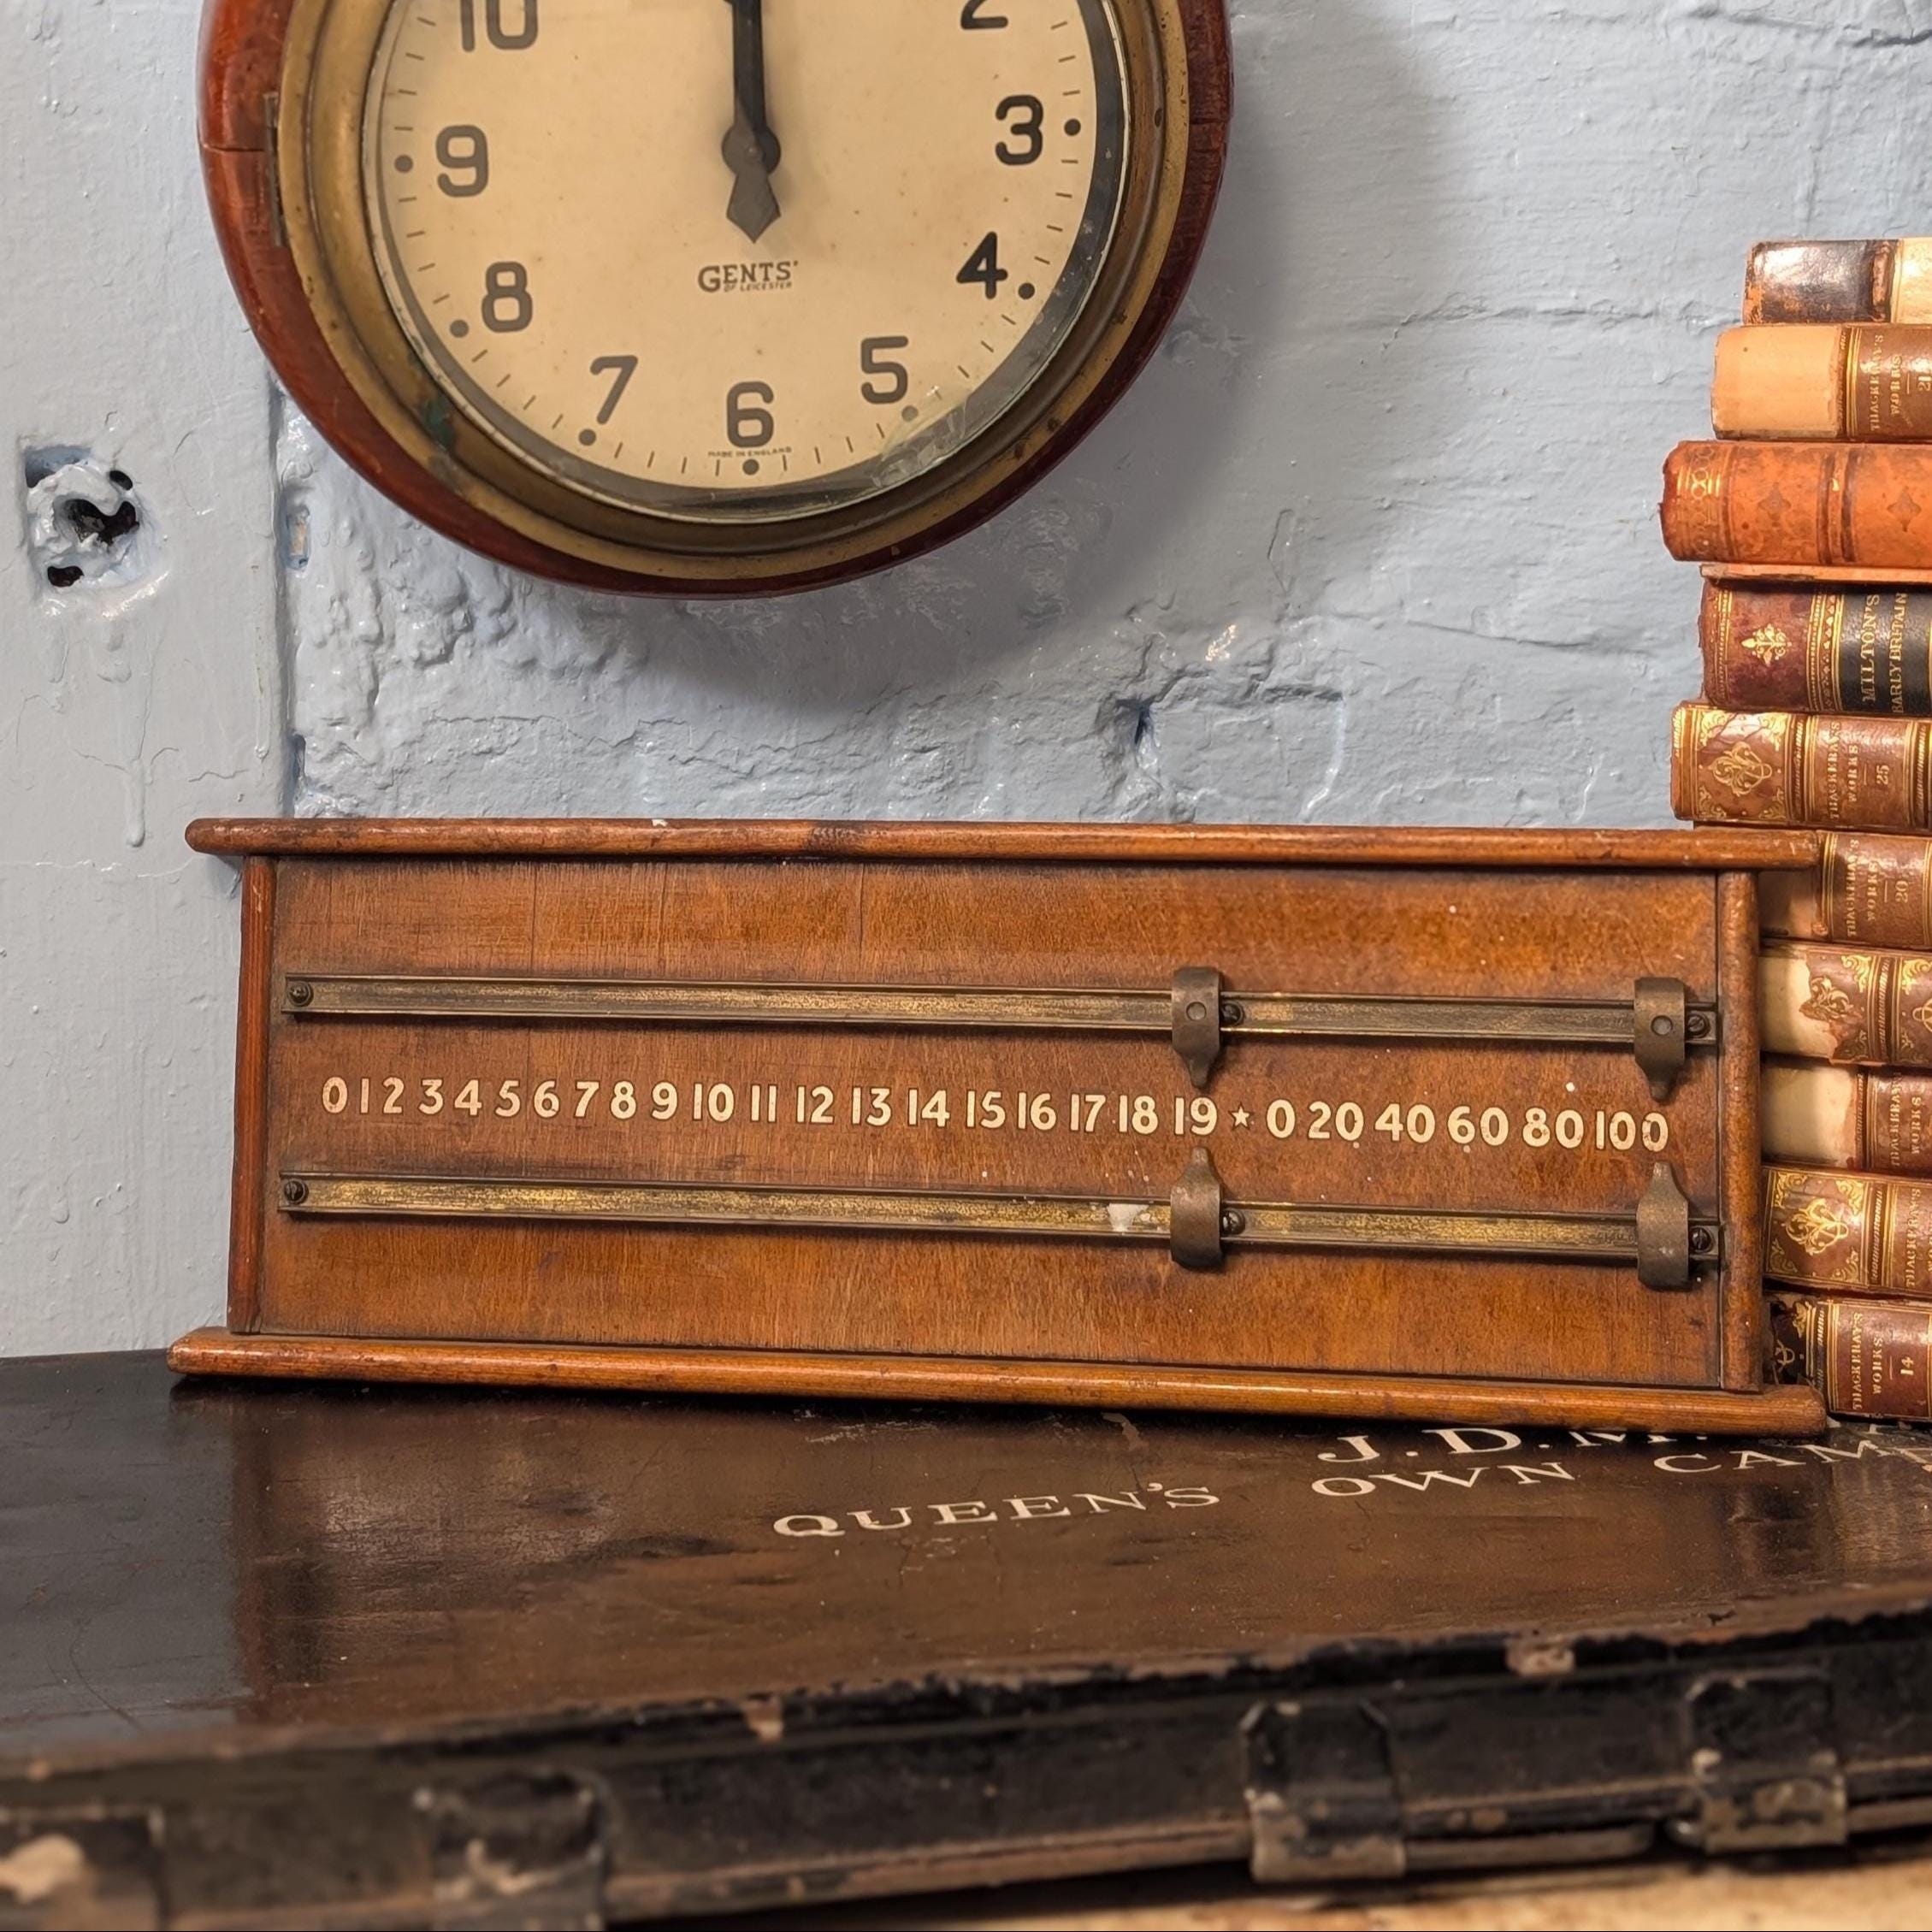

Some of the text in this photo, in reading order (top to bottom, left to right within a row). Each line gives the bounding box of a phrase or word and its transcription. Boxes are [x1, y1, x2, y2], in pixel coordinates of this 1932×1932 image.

[460, 0, 538, 52] 10
[996, 94, 1044, 165] 3
[435, 125, 488, 198] 9
[482, 261, 533, 333] 8
[698, 260, 798, 292] GENTS'
[740, 281, 792, 292] LEICESTER
[955, 232, 1008, 299] 4
[590, 355, 639, 425] 7
[860, 335, 909, 405] 5
[726, 381, 774, 448] 6
[747, 446, 792, 457] ENGLAND
[1860, 594, 1880, 702] MILTON'S
[1847, 745, 1858, 802] WORKS
[1876, 765, 1890, 785] 25
[1867, 862, 1878, 921] WORKS
[1895, 880, 1909, 903] 20
[322, 1077, 1669, 1152] 0 1 2 3 4 5 6 7 8 9 10 11 12 13 14 15 16 17 18 19 0 20 40 60 80 100
[1911, 1096, 1922, 1155] WORKS
[1900, 1356, 1915, 1376] 14
[773, 1482, 1220, 1537] QUEEN'S
[1311, 1462, 1575, 1496] OWN
